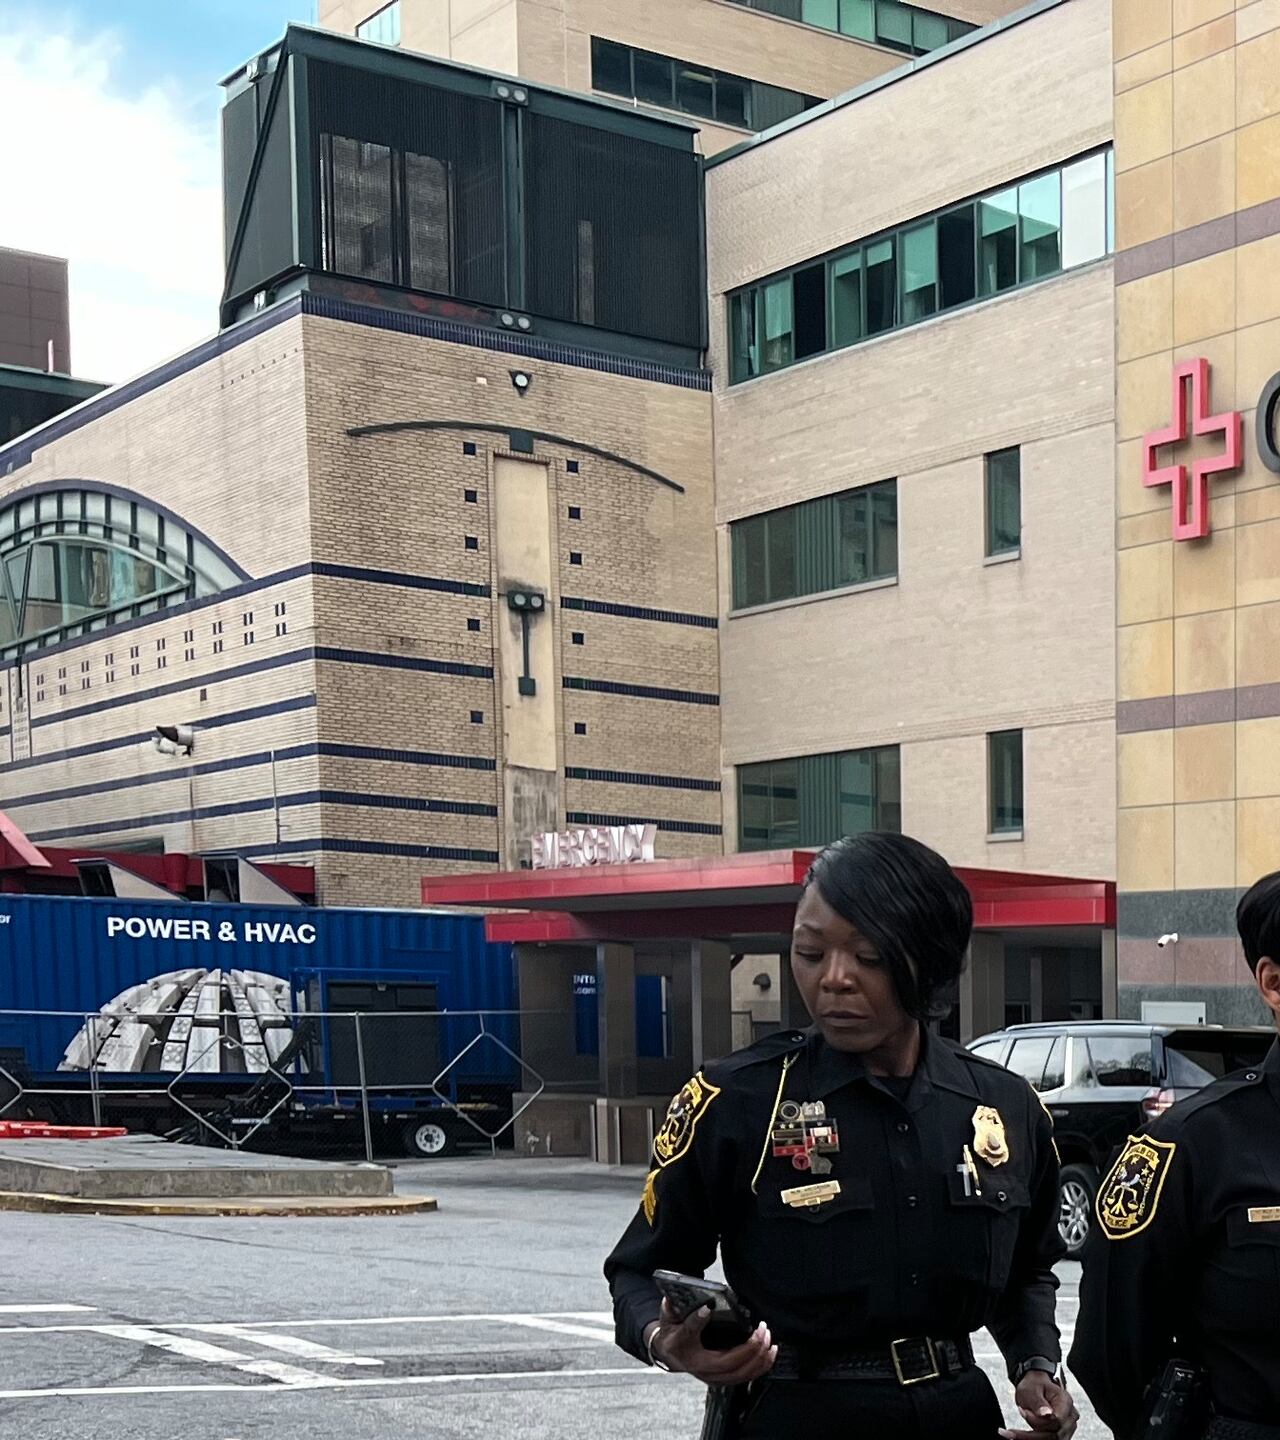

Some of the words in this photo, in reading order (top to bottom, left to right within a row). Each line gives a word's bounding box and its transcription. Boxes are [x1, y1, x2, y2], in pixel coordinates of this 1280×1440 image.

[532, 824, 657, 870] EMERGENCY
[107, 916, 210, 941] POWER
[217, 921, 237, 942] &
[244, 922, 316, 944] HVAC
